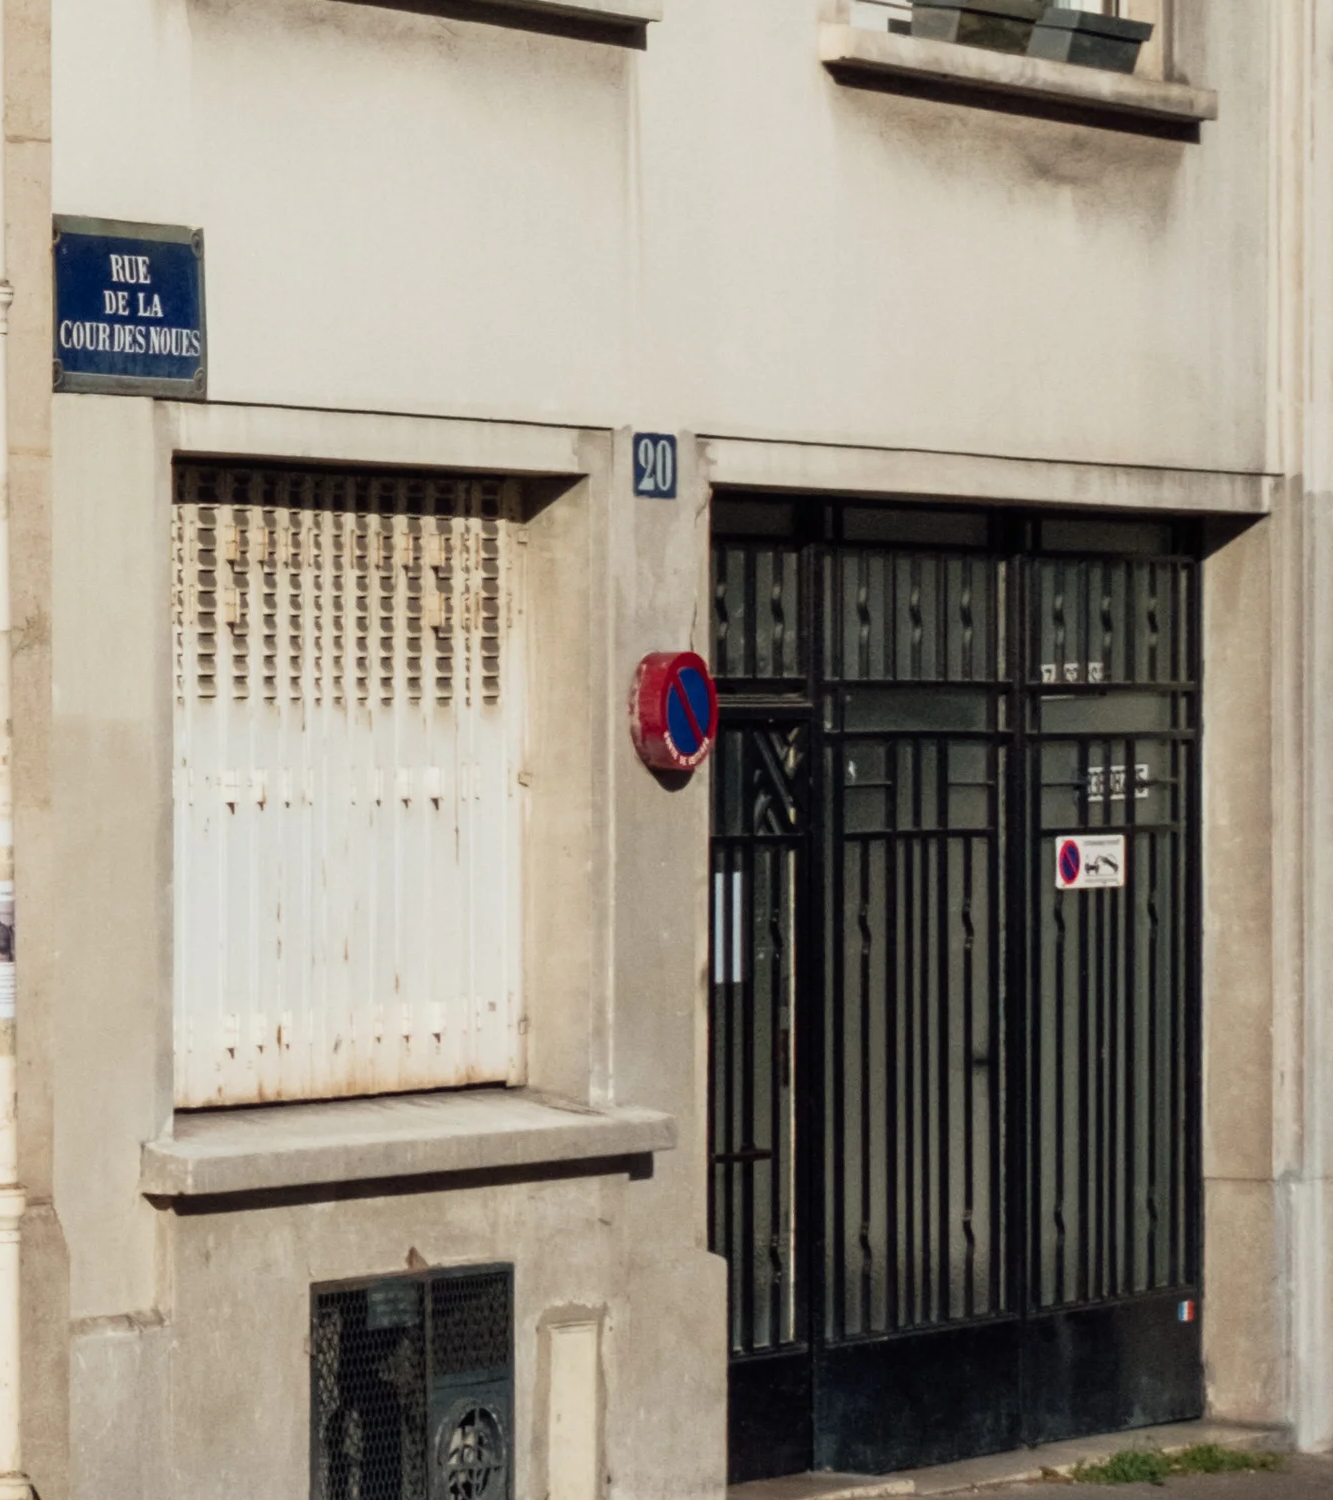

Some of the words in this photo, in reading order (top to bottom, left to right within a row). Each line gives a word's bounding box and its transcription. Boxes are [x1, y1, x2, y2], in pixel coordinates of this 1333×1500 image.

[109, 254, 151, 284] RUE
[103, 290, 129, 315] DE
[137, 292, 164, 318] LA
[59, 320, 110, 350] COUR
[113, 323, 146, 353] DES
[149, 326, 201, 356] NOUES
[637, 438, 673, 491] 20
